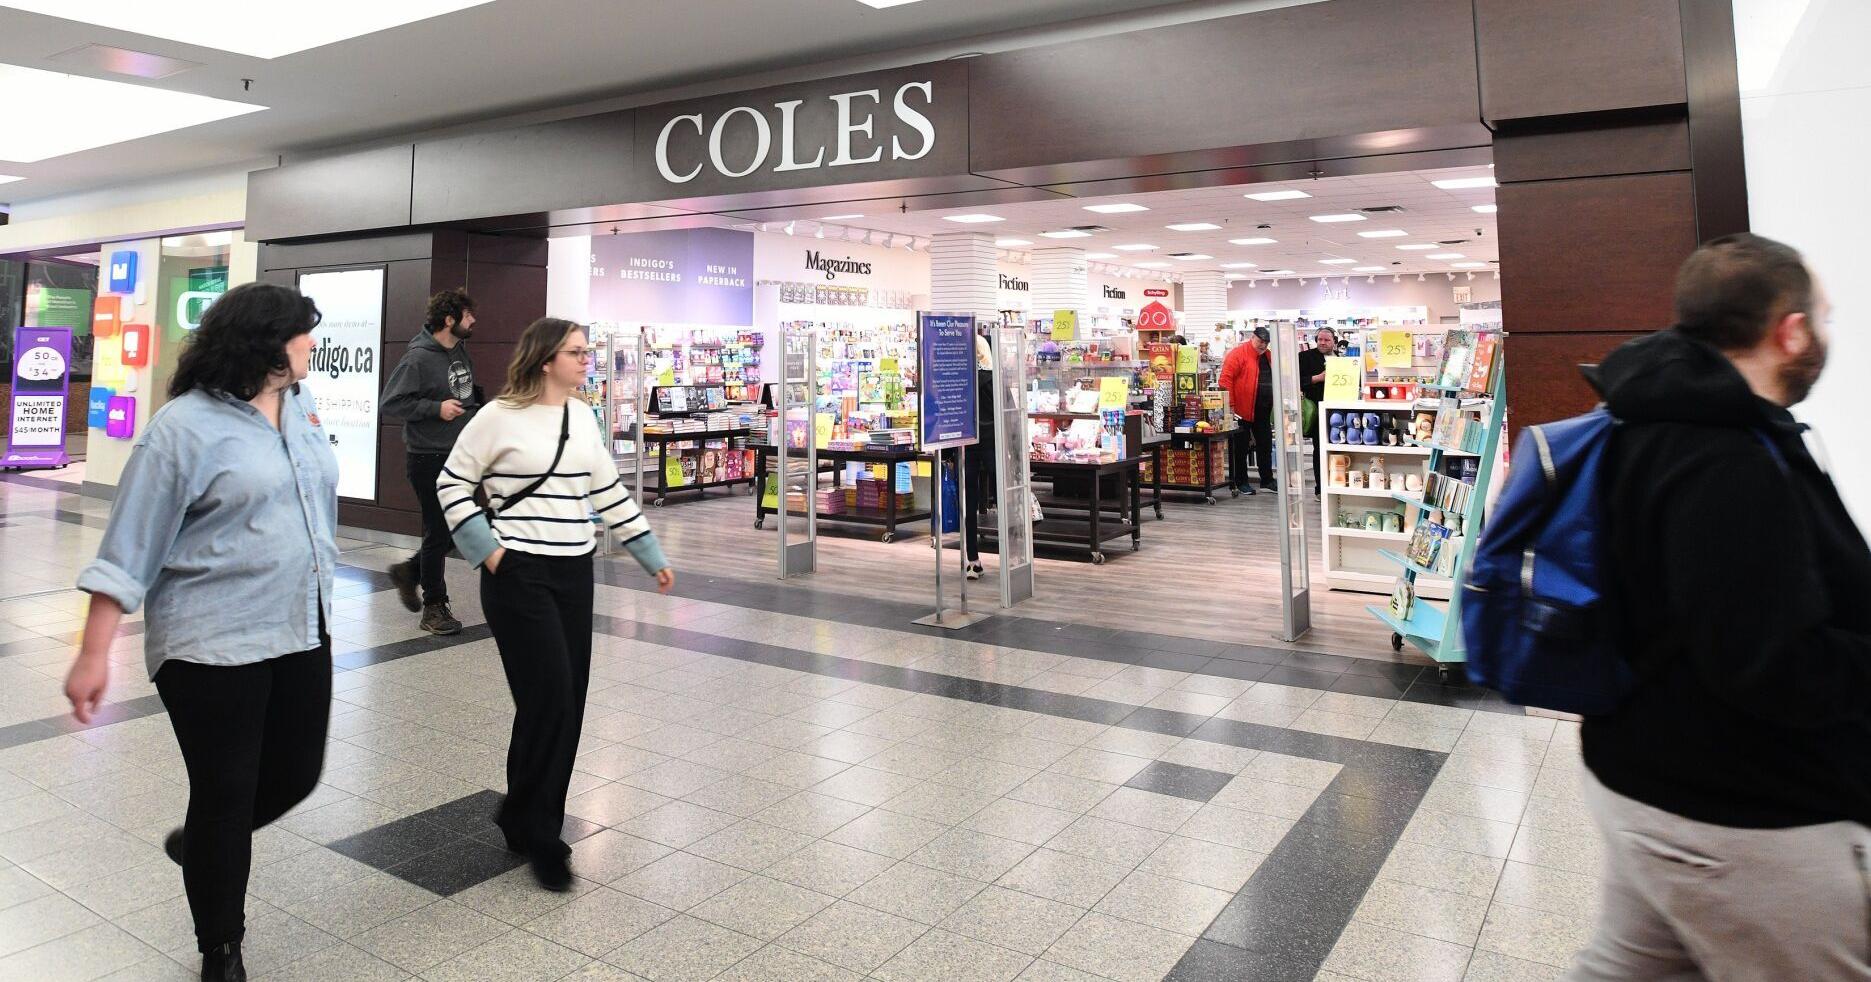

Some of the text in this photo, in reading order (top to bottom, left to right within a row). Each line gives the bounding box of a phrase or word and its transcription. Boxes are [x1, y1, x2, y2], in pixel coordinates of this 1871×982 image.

[655, 81, 936, 184] COLES
[629, 256, 675, 270] INDIGO'S
[706, 264, 737, 276] NEW IN
[805, 249, 872, 281] Magazines
[620, 269, 681, 283] BESTSELLERS
[697, 275, 745, 288] PAPERBACK
[998, 273, 1029, 292] Fiction
[1103, 284, 1126, 300] Fiction
[308, 337, 374, 379] ndigo.ca
[23, 407, 54, 415] HOME
[326, 398, 371, 413] SHIPPING
